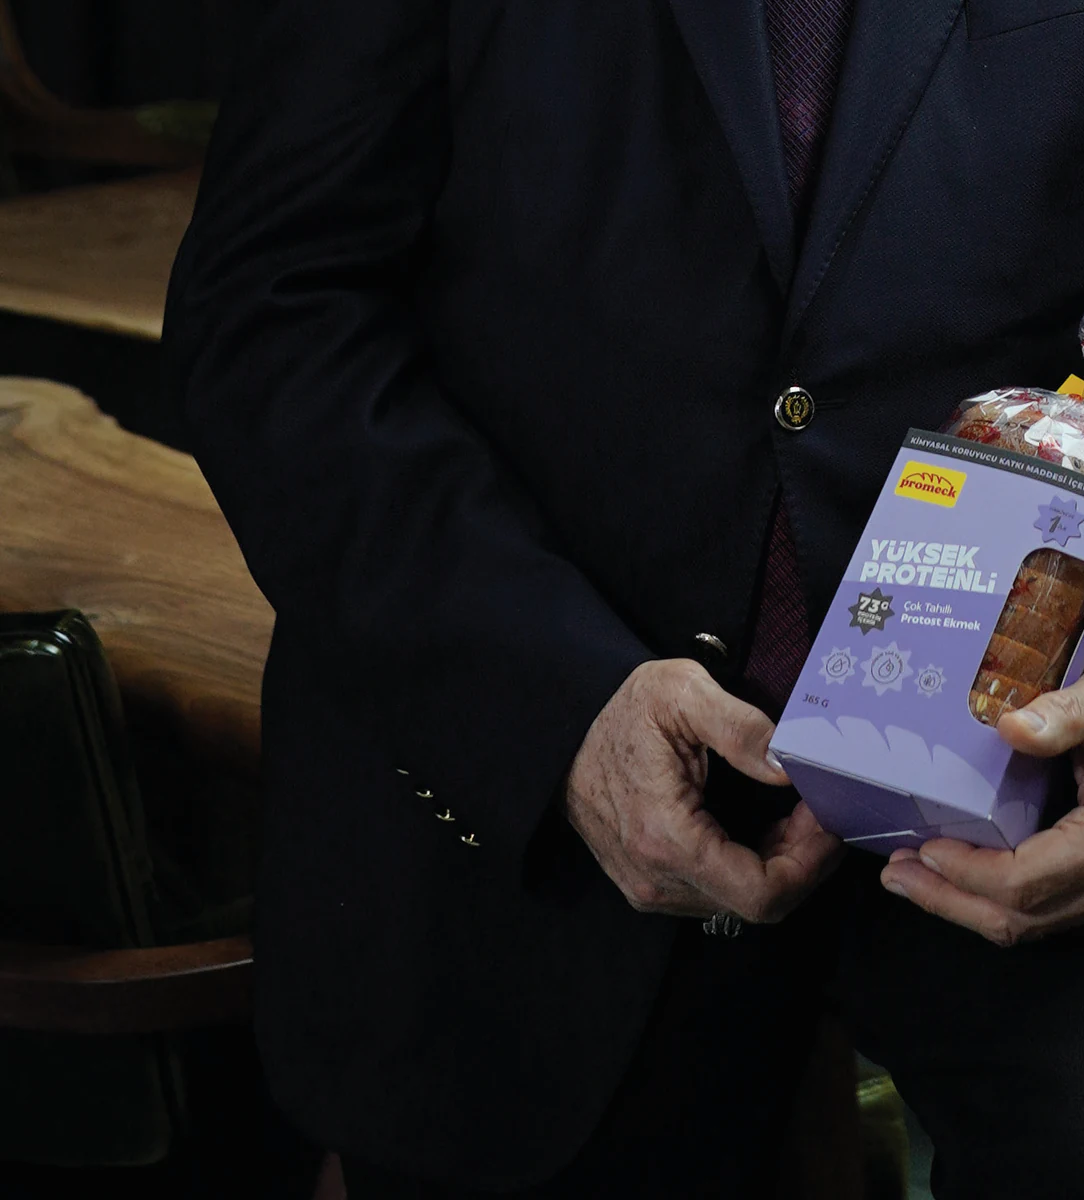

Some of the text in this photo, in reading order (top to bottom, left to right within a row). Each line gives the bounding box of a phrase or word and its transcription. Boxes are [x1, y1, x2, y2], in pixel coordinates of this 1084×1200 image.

[910, 436, 950, 452] KİMYASAL
[951, 445, 998, 462] KORUYUCU
[999, 456, 1024, 470] KATKI
[1026, 465, 1067, 484] MADDESİ
[899, 477, 957, 499] promeck
[871, 539, 981, 569] YÜKSEK
[903, 600, 922, 613] Çok
[900, 614, 981, 631] Protost Ekmek
[821, 698, 830, 709] G
